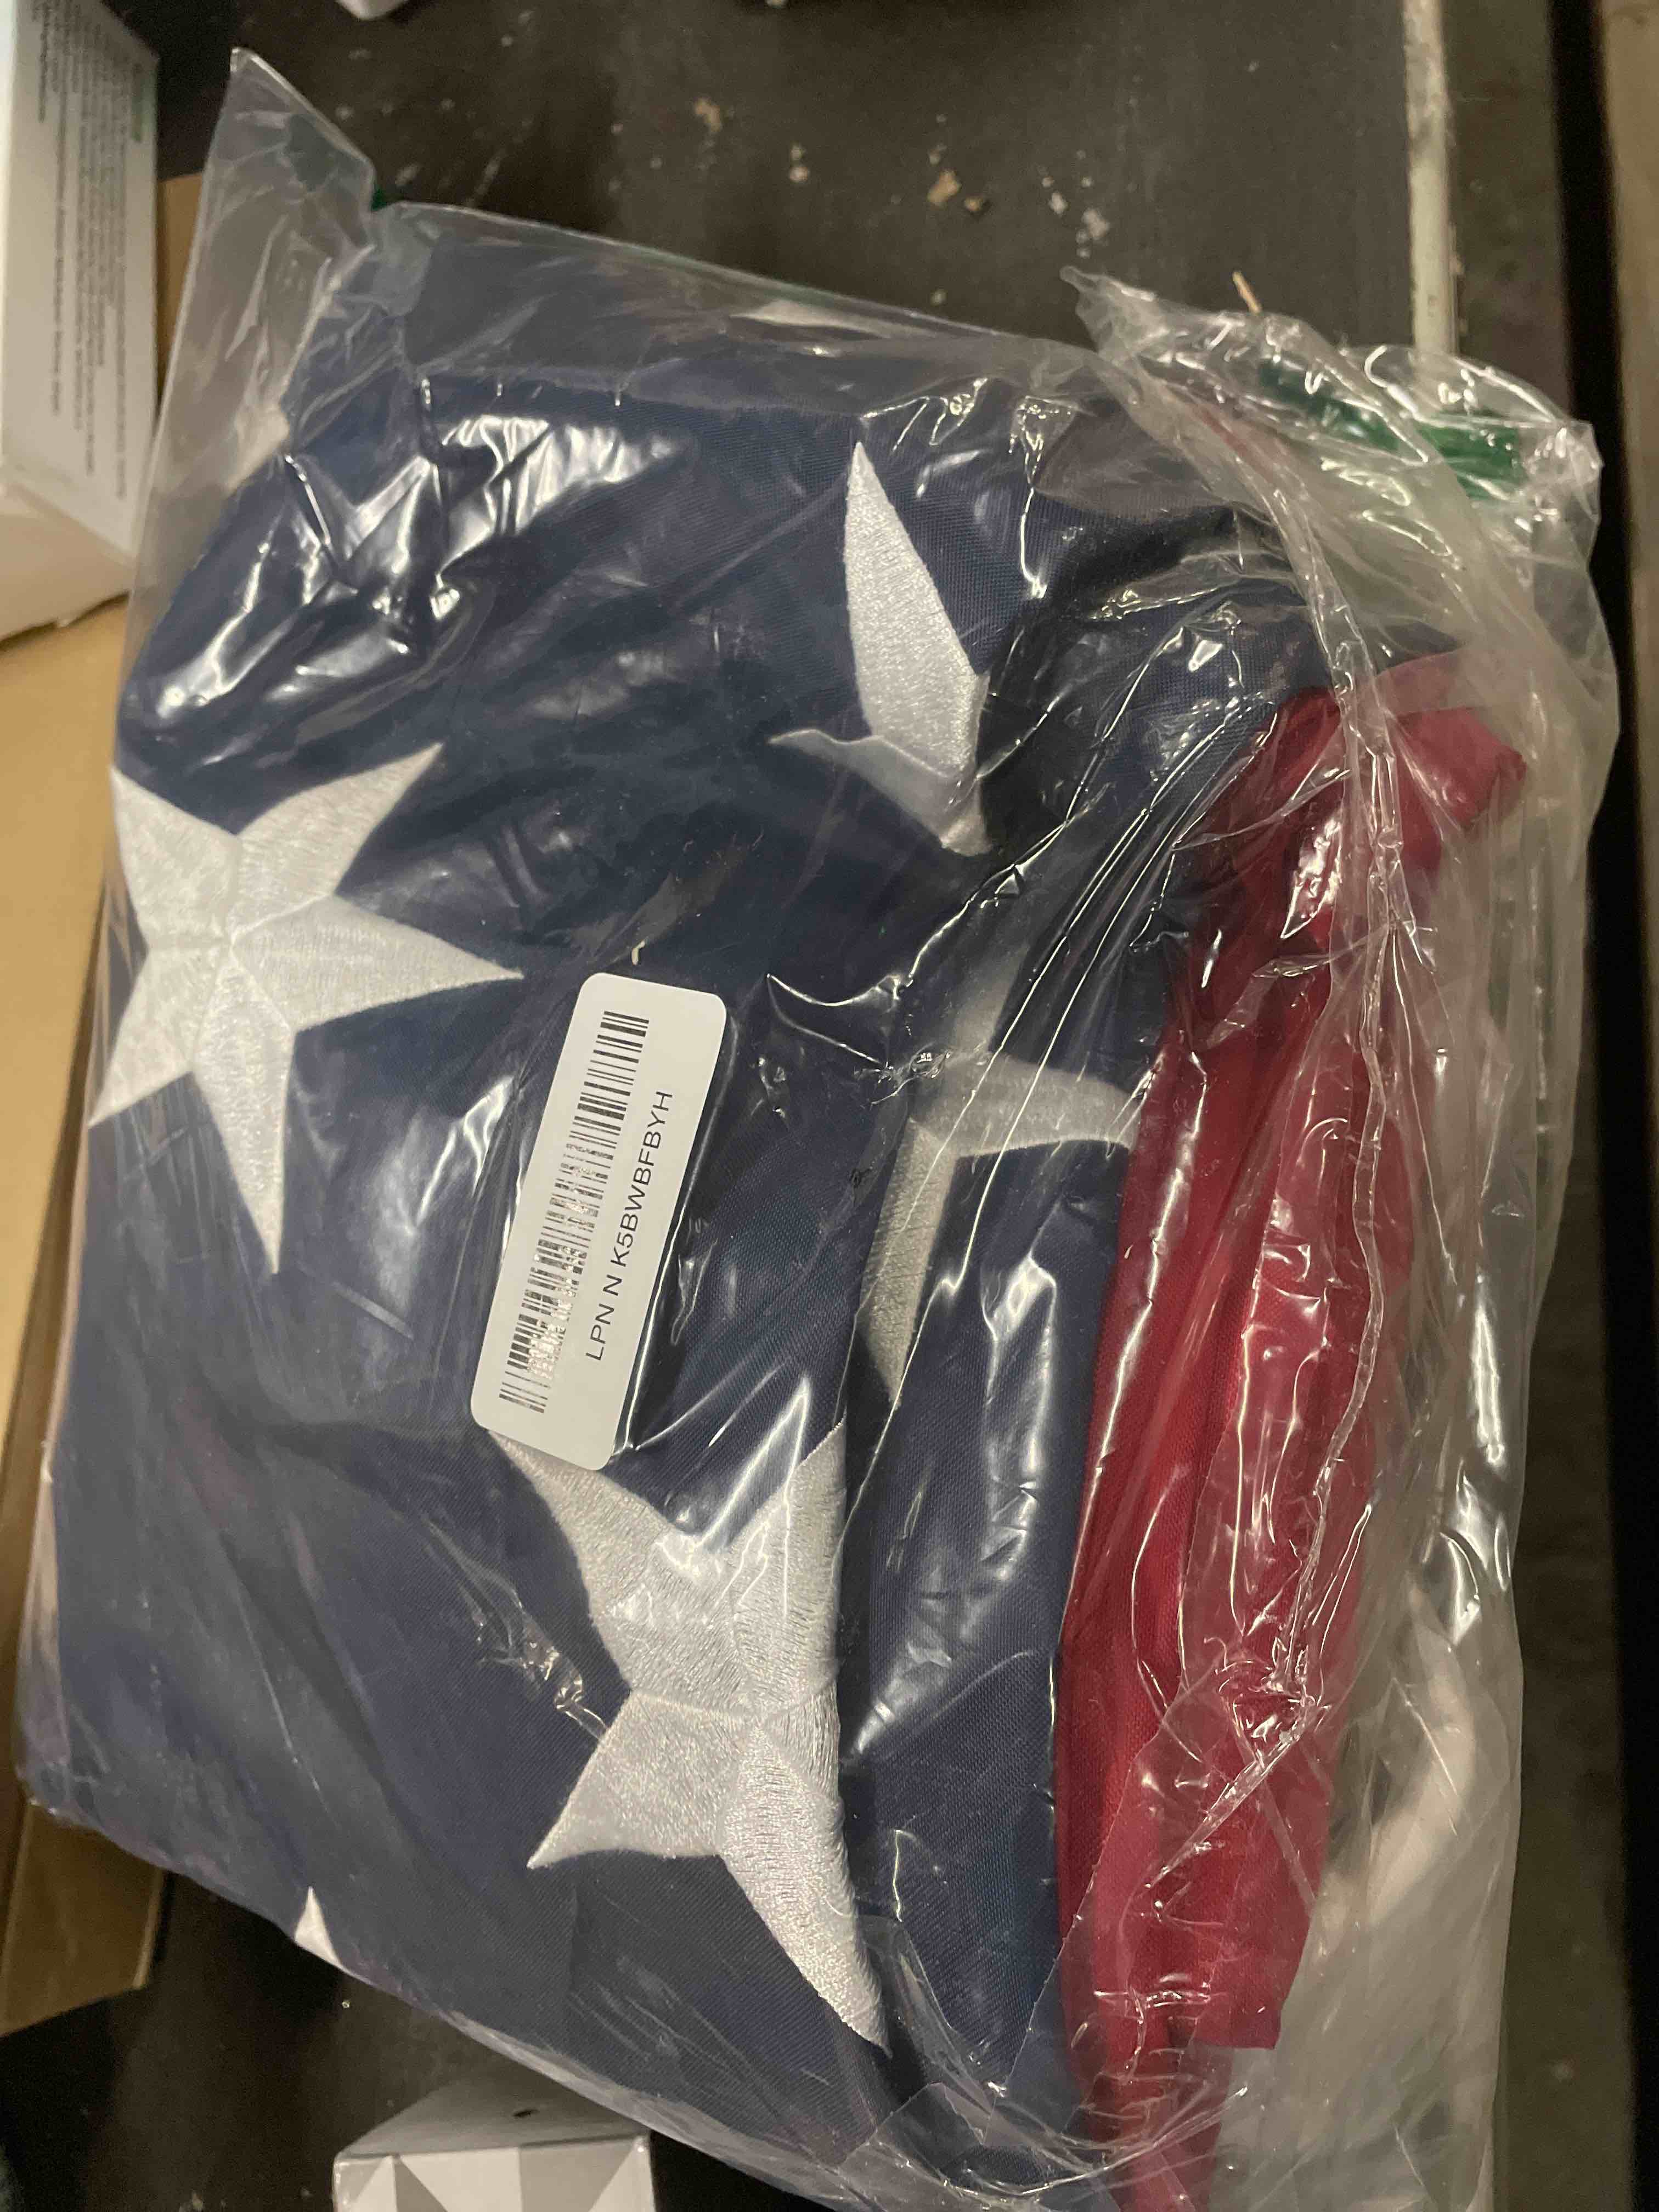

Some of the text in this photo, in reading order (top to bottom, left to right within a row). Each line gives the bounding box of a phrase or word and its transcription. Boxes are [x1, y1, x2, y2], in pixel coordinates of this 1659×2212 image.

[586, 1091, 673, 1361] LPN N K5BWBFBYH
